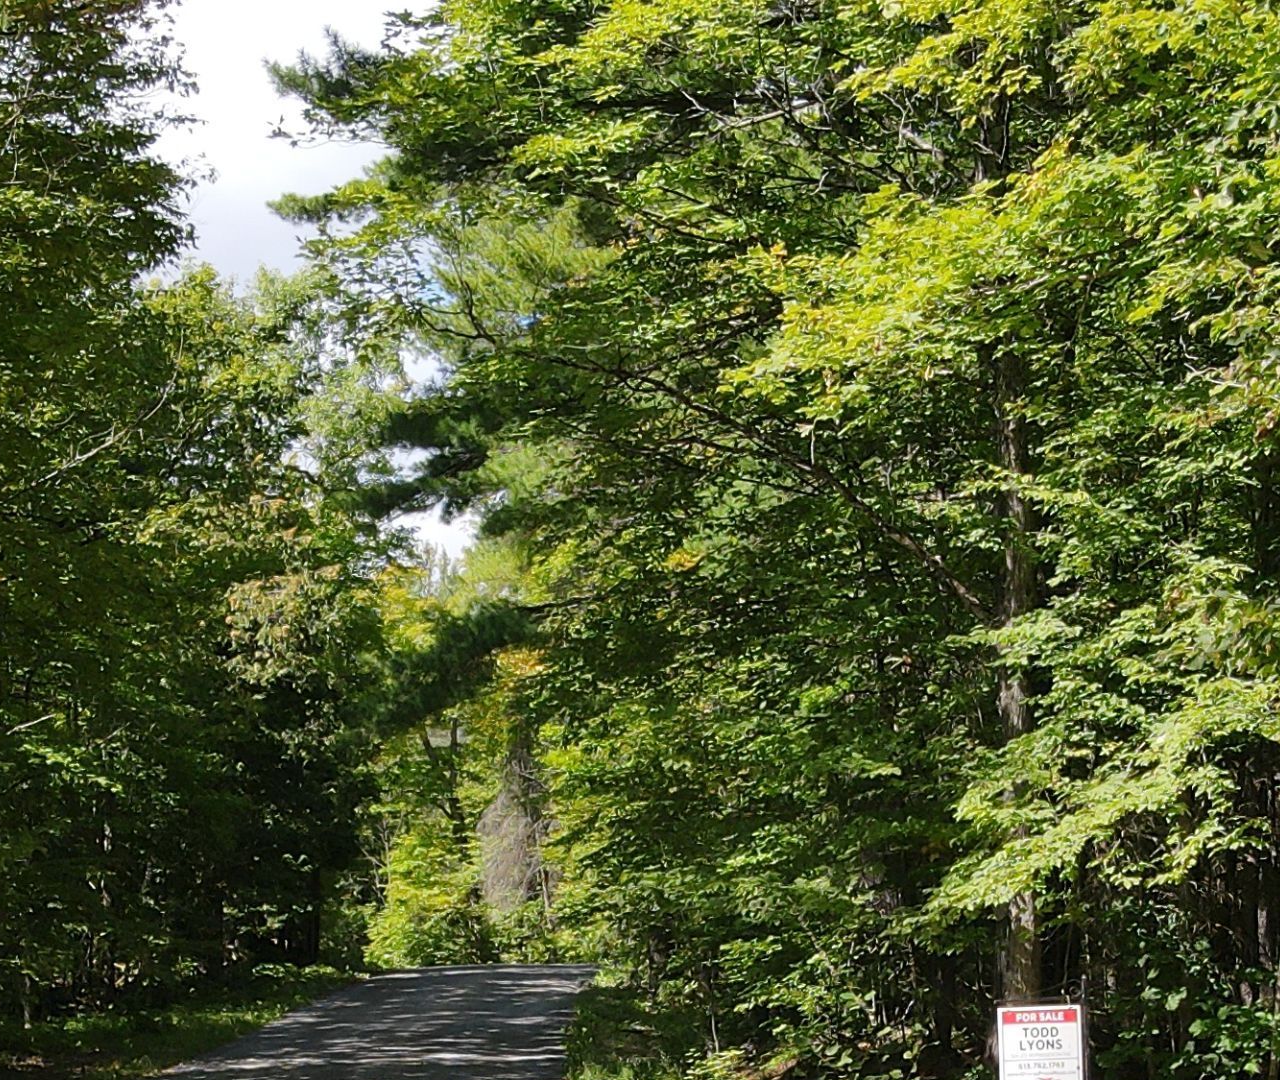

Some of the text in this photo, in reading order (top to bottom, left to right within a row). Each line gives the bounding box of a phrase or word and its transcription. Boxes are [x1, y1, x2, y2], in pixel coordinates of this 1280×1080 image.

[1015, 1011, 1065, 1022] FOR SALE
[1022, 1027, 1059, 1038] TODD
[1019, 1039, 1063, 1051] LYONS
